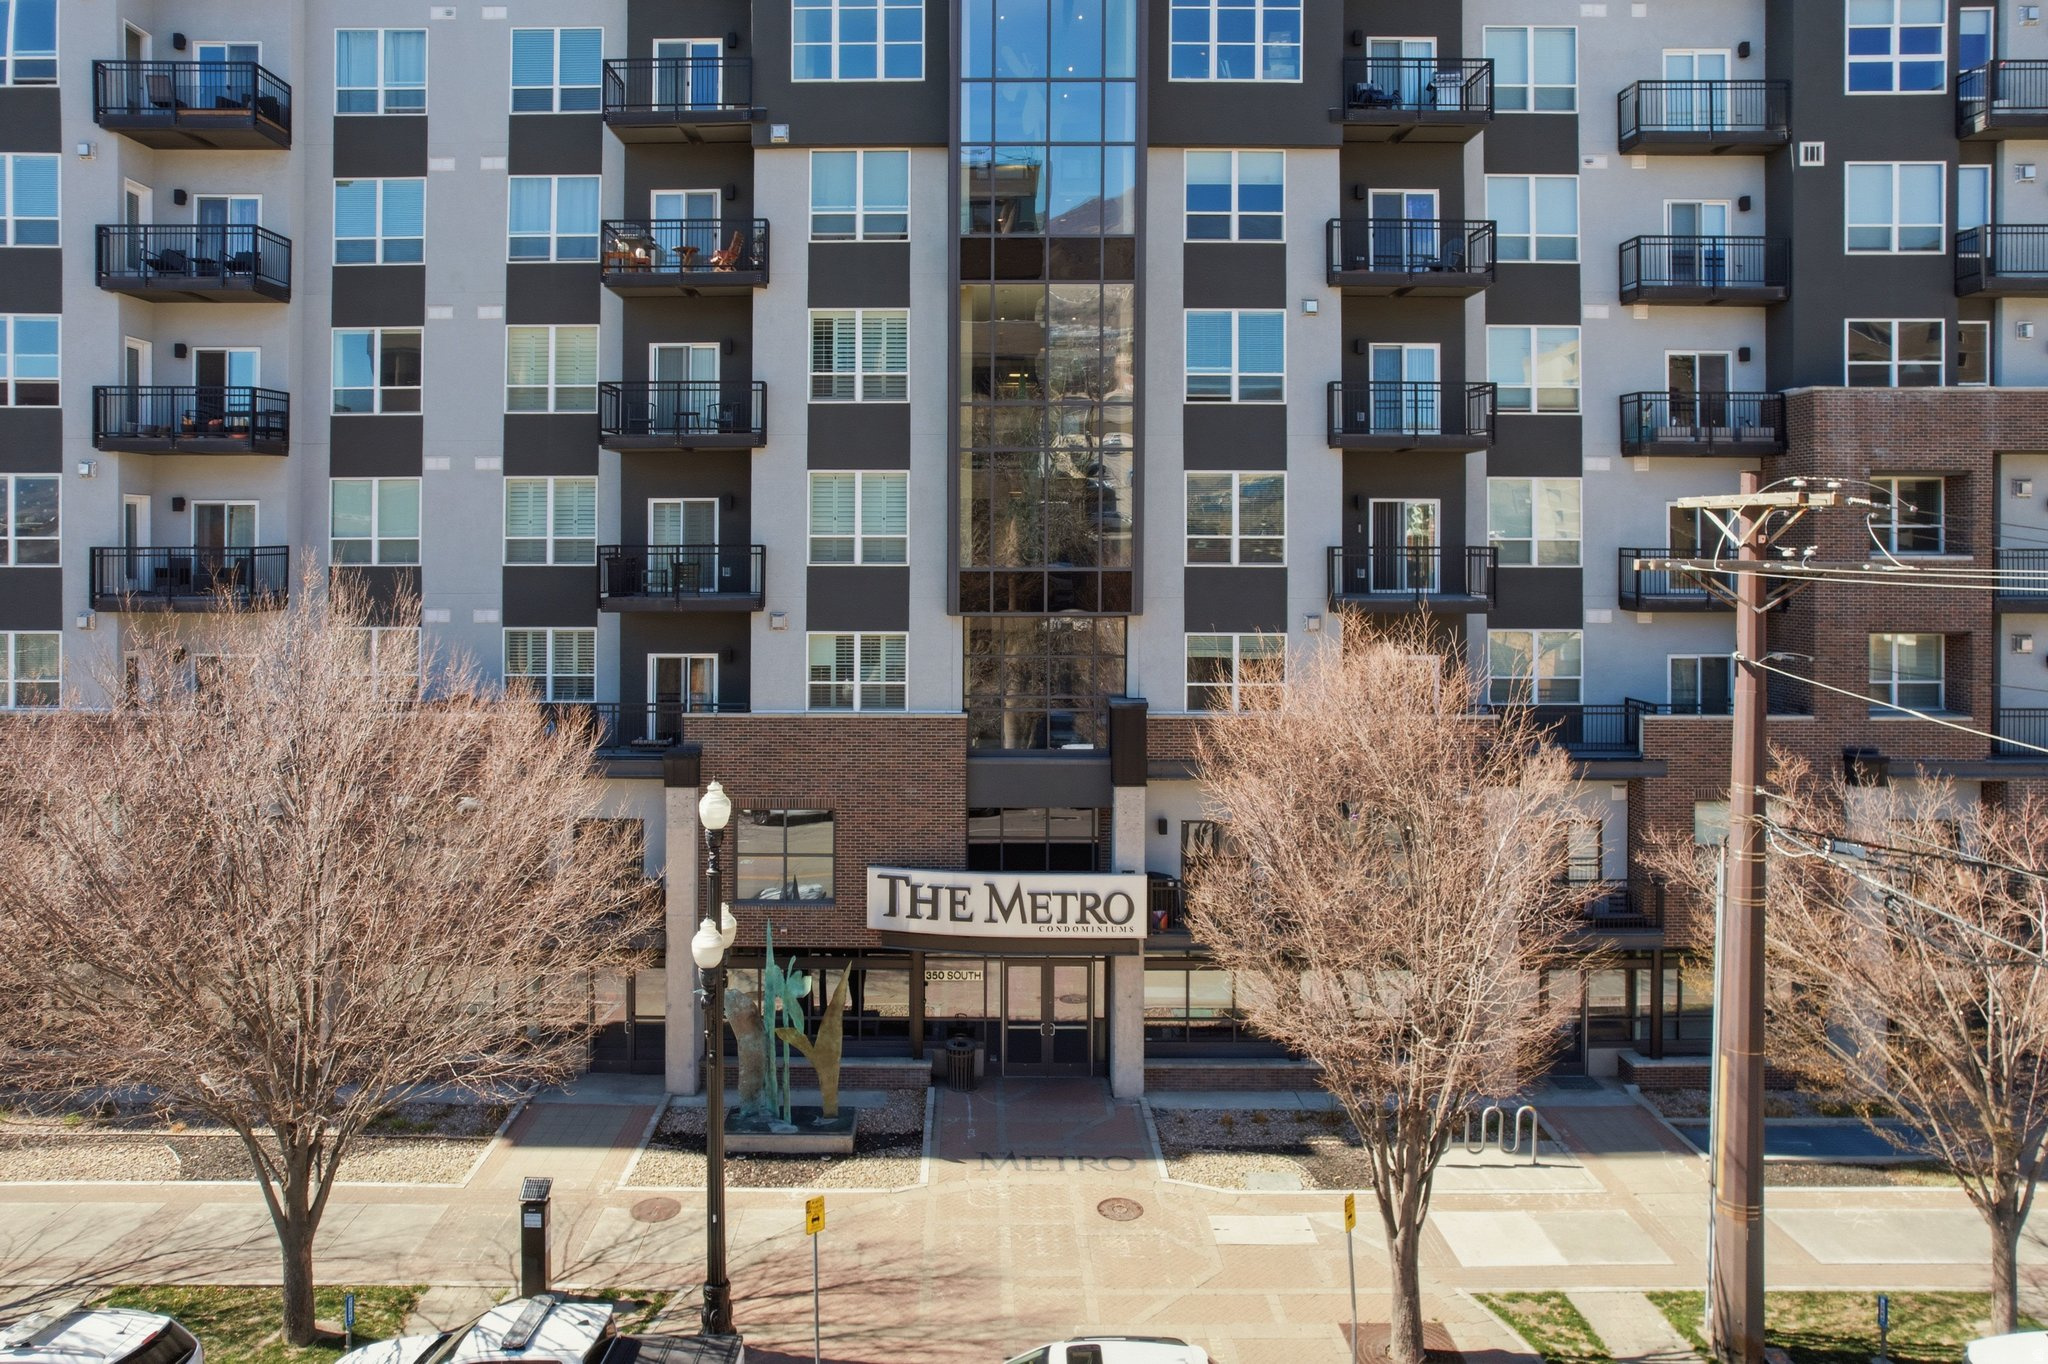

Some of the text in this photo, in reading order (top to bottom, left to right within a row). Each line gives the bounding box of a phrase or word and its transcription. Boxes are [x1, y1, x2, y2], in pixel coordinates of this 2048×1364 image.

[877, 873, 1135, 925] THE METRO
[1038, 925, 1134, 933] CONDOMINIUMS
[925, 970, 981, 980] 350 SOUTH
[976, 1151, 1136, 1172] METRO
